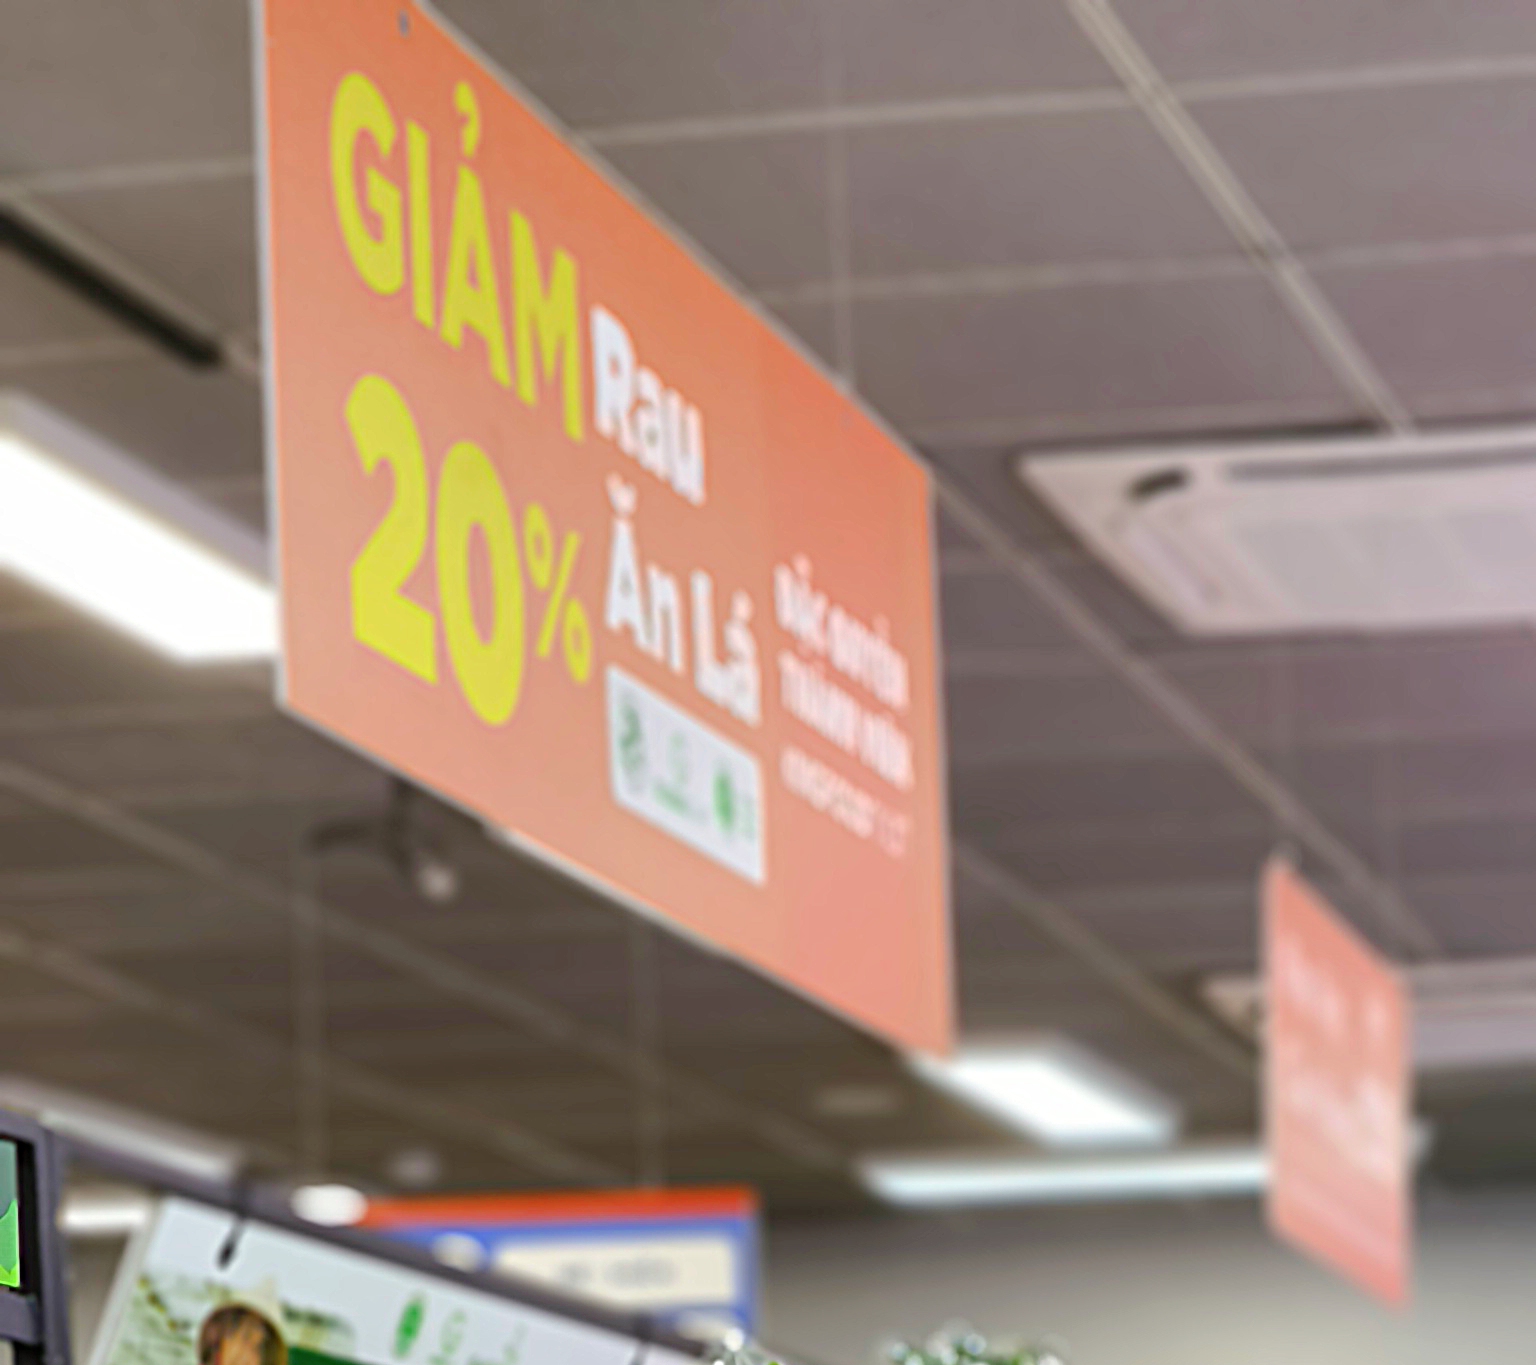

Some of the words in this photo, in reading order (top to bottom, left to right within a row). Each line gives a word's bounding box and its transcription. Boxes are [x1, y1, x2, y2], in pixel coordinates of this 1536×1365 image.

[330, 72, 584, 444] GIẢM
[590, 305, 704, 504] Rau
[343, 373, 593, 727] 20%
[604, 472, 684, 672] Ăn
[694, 571, 761, 726] Lá
